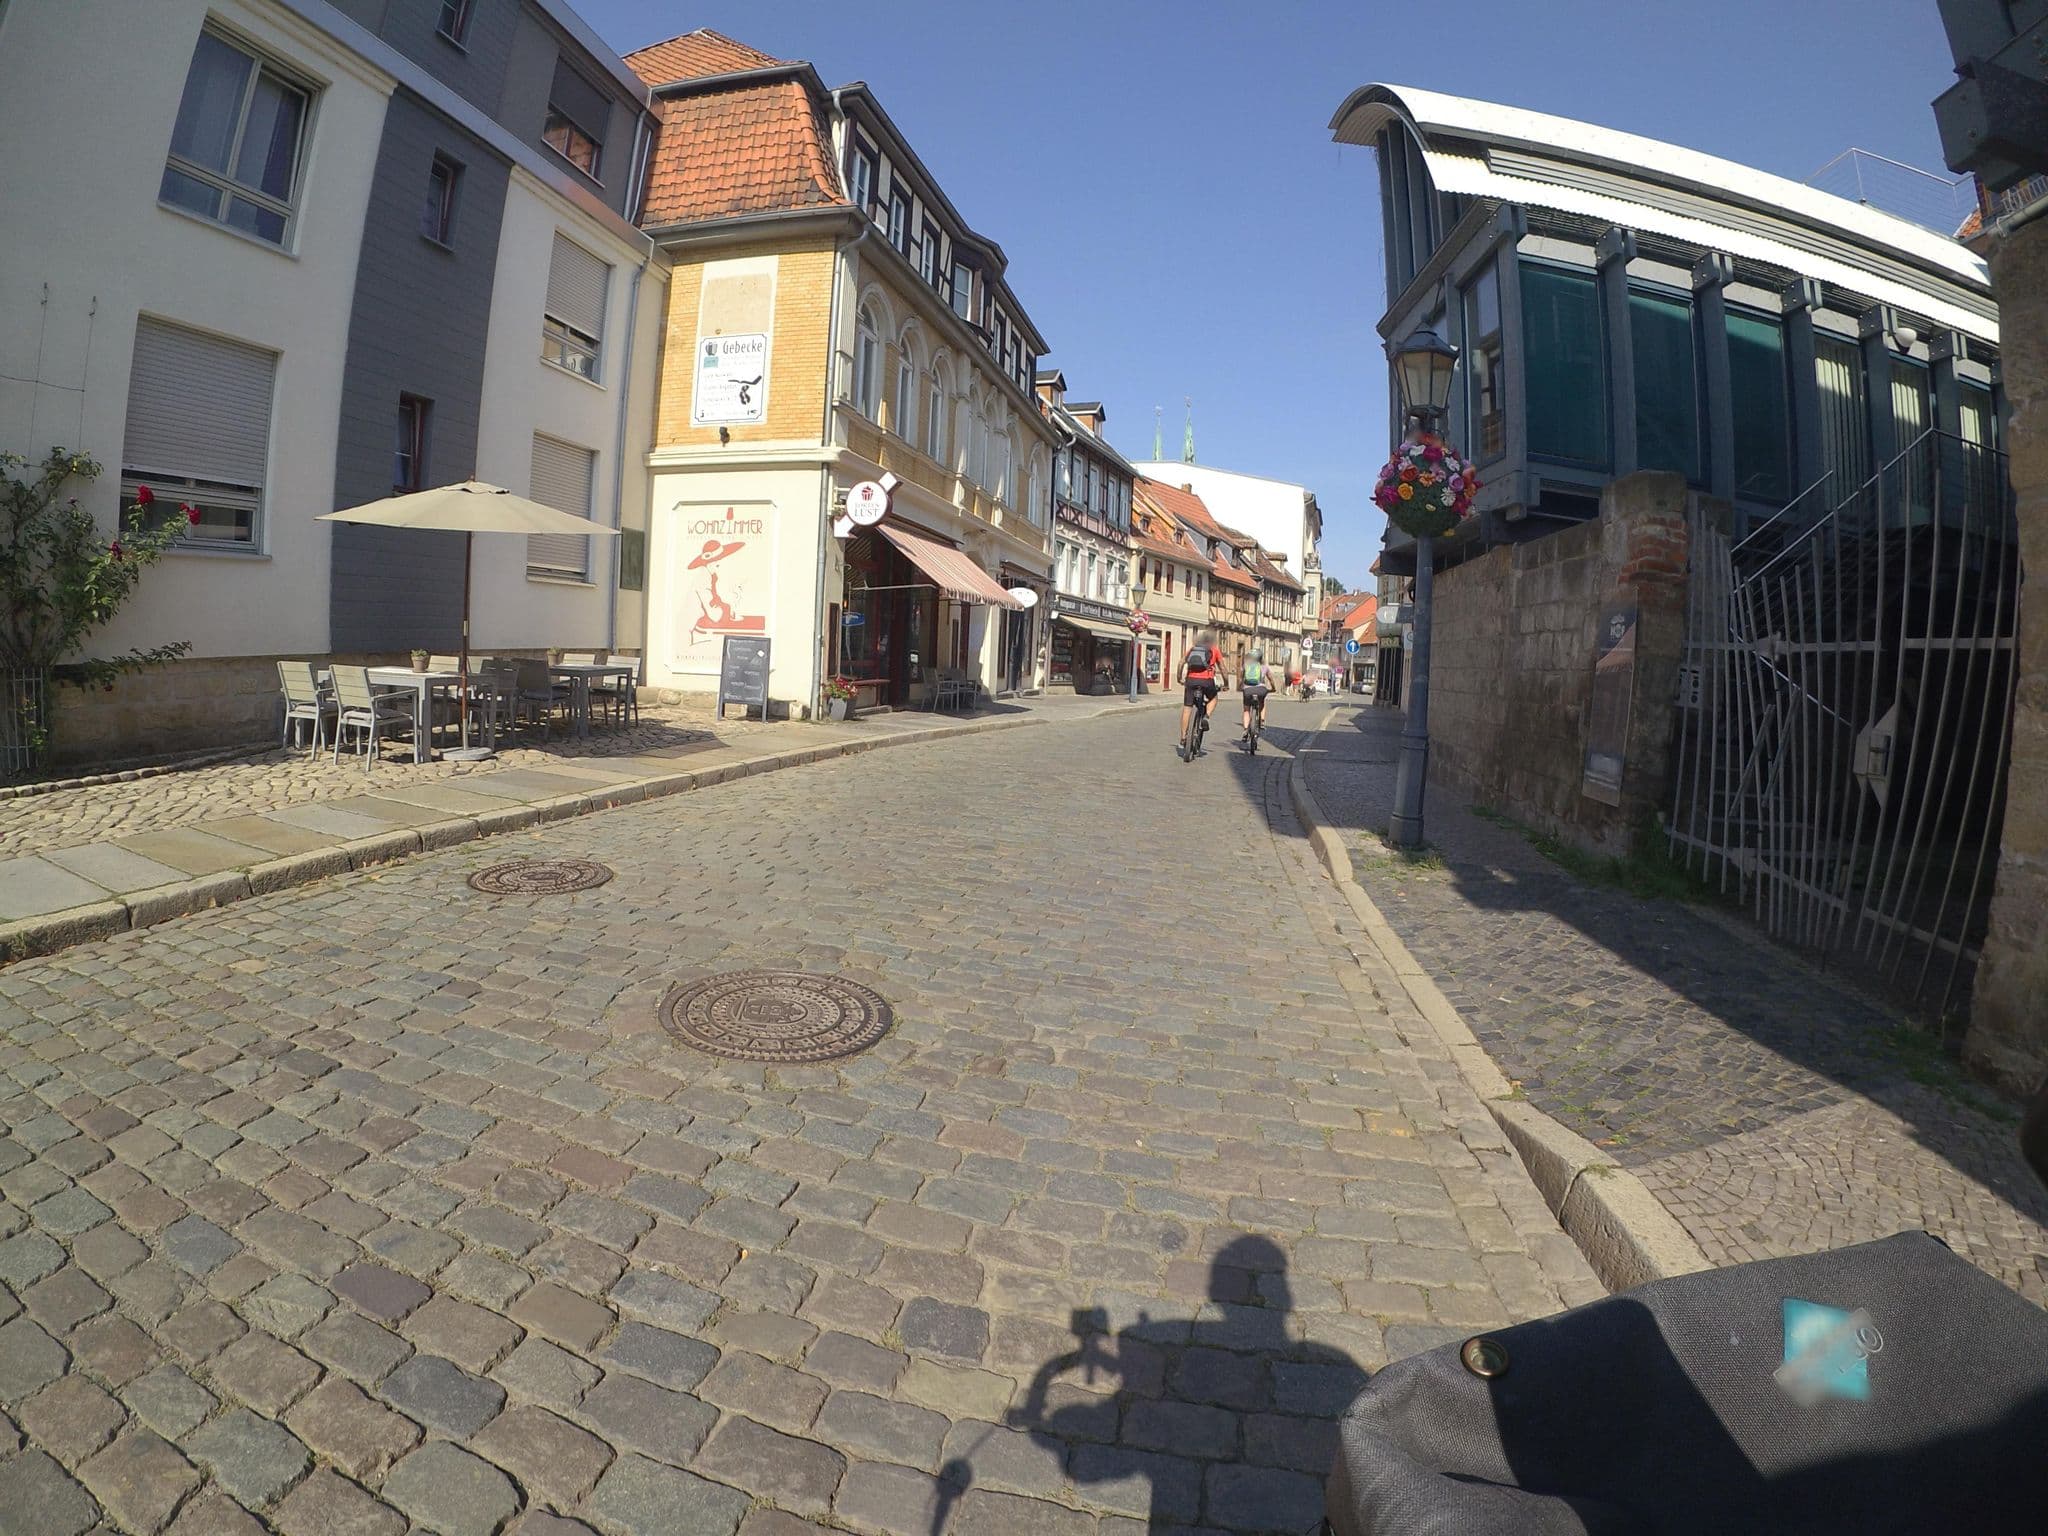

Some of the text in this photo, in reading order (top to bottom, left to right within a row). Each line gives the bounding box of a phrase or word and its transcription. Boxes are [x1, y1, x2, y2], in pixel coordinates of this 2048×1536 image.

[723, 340, 762, 354] Gebecke
[855, 508, 881, 517] LUST
[687, 520, 763, 534] WOHNZIMMER
